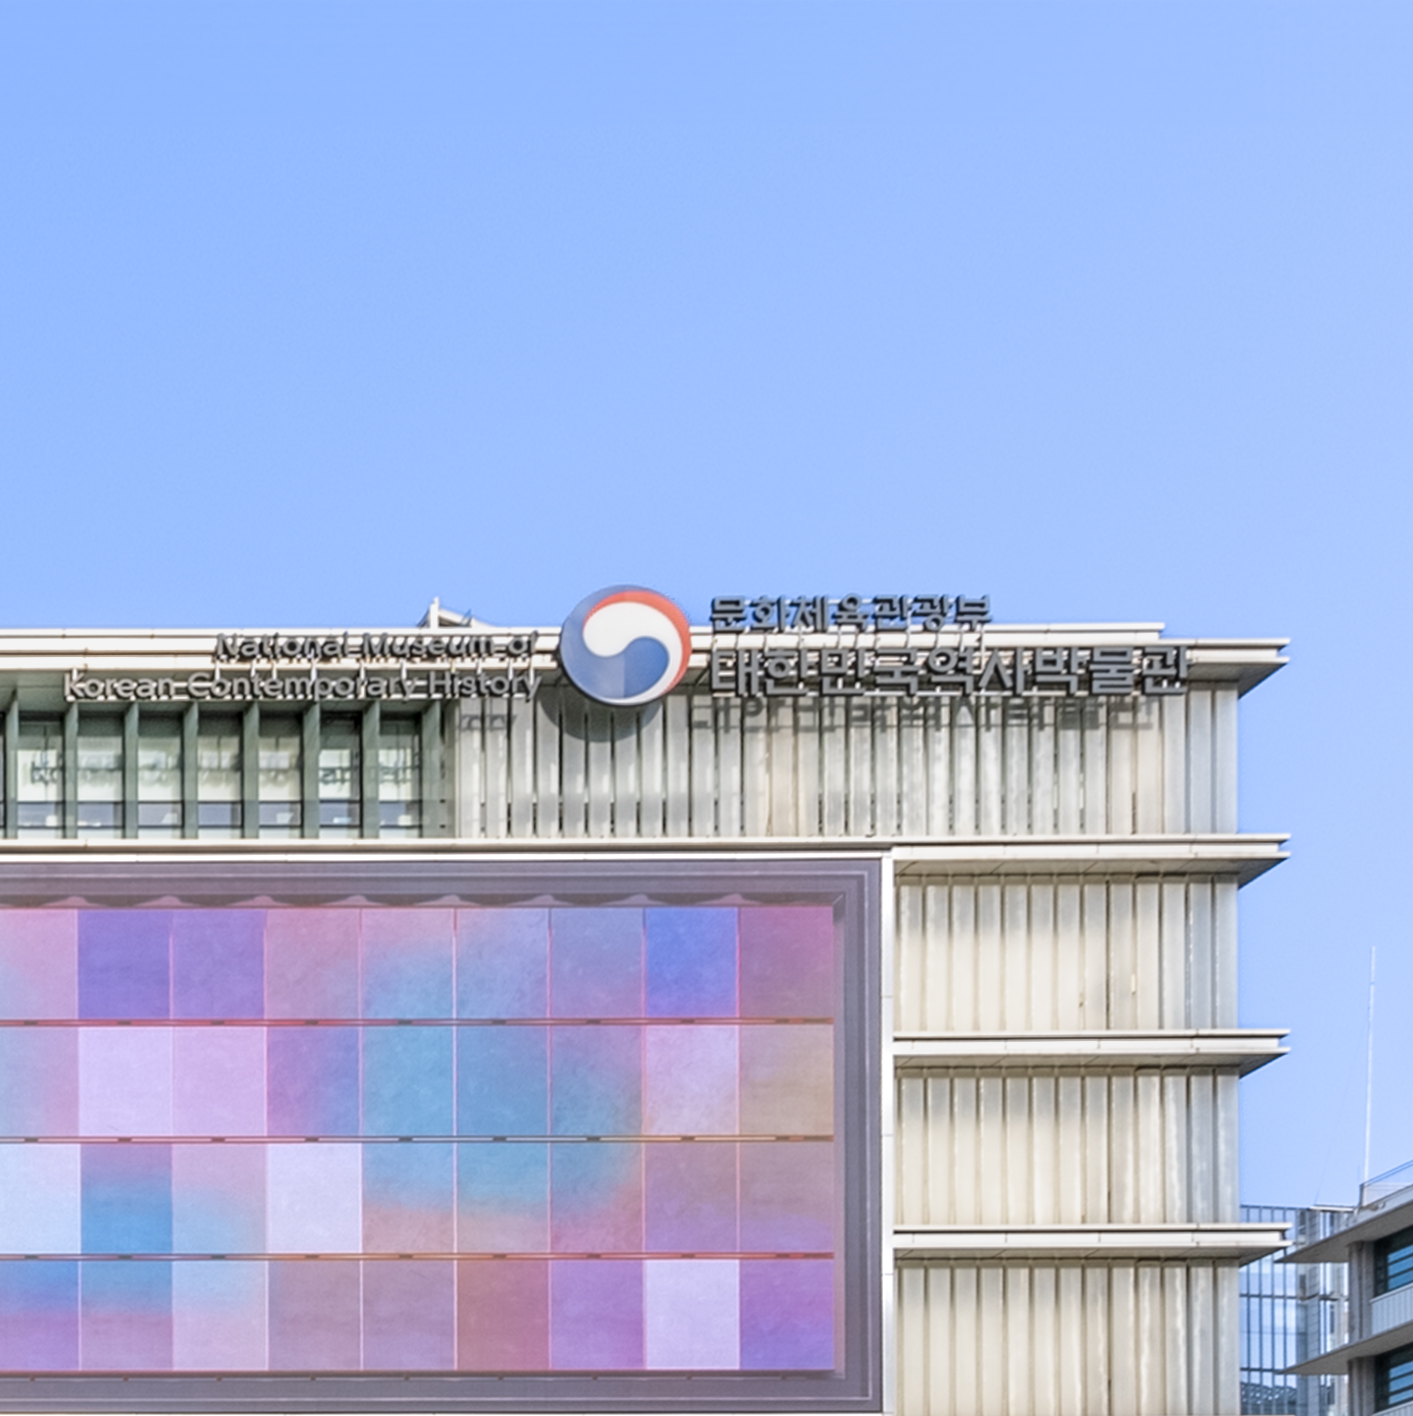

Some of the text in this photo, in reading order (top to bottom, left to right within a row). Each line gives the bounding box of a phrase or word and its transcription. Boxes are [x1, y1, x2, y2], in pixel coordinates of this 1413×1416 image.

[710, 593, 993, 632] 문화체육관광부
[215, 629, 539, 660] National Museum of
[63, 669, 542, 704] Korean Contemporary History
[709, 645, 1192, 698] 대한민국역사박물관
